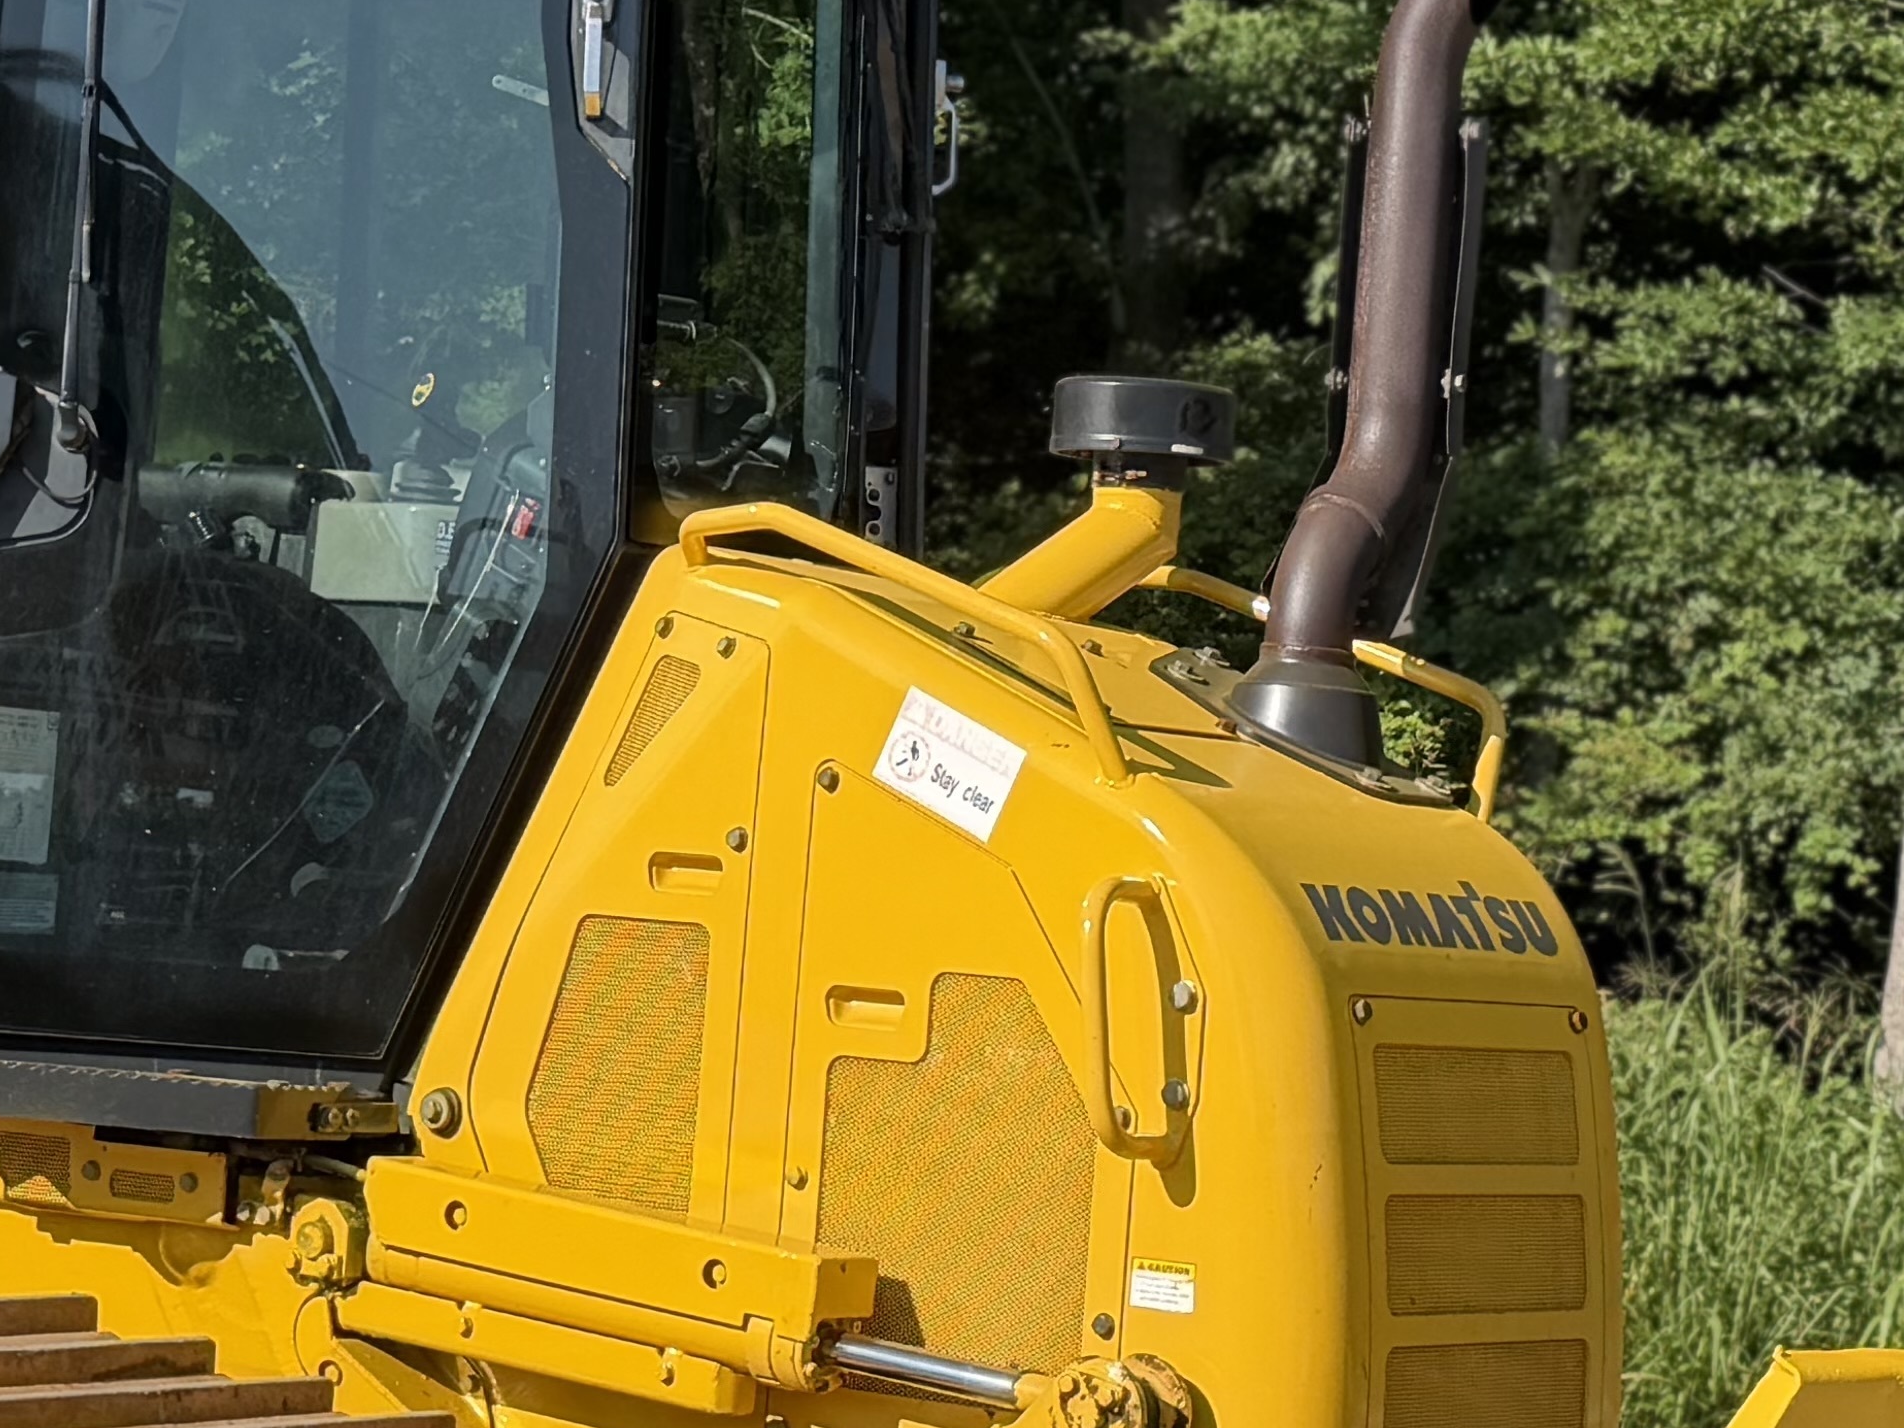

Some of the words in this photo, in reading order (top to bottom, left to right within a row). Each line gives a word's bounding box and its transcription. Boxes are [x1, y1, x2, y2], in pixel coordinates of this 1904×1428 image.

[930, 763, 960, 798] Stay
[962, 785, 995, 814] clear
[1299, 880, 1558, 957] KOMATSU
[1147, 1263, 1190, 1276] CAUTION
